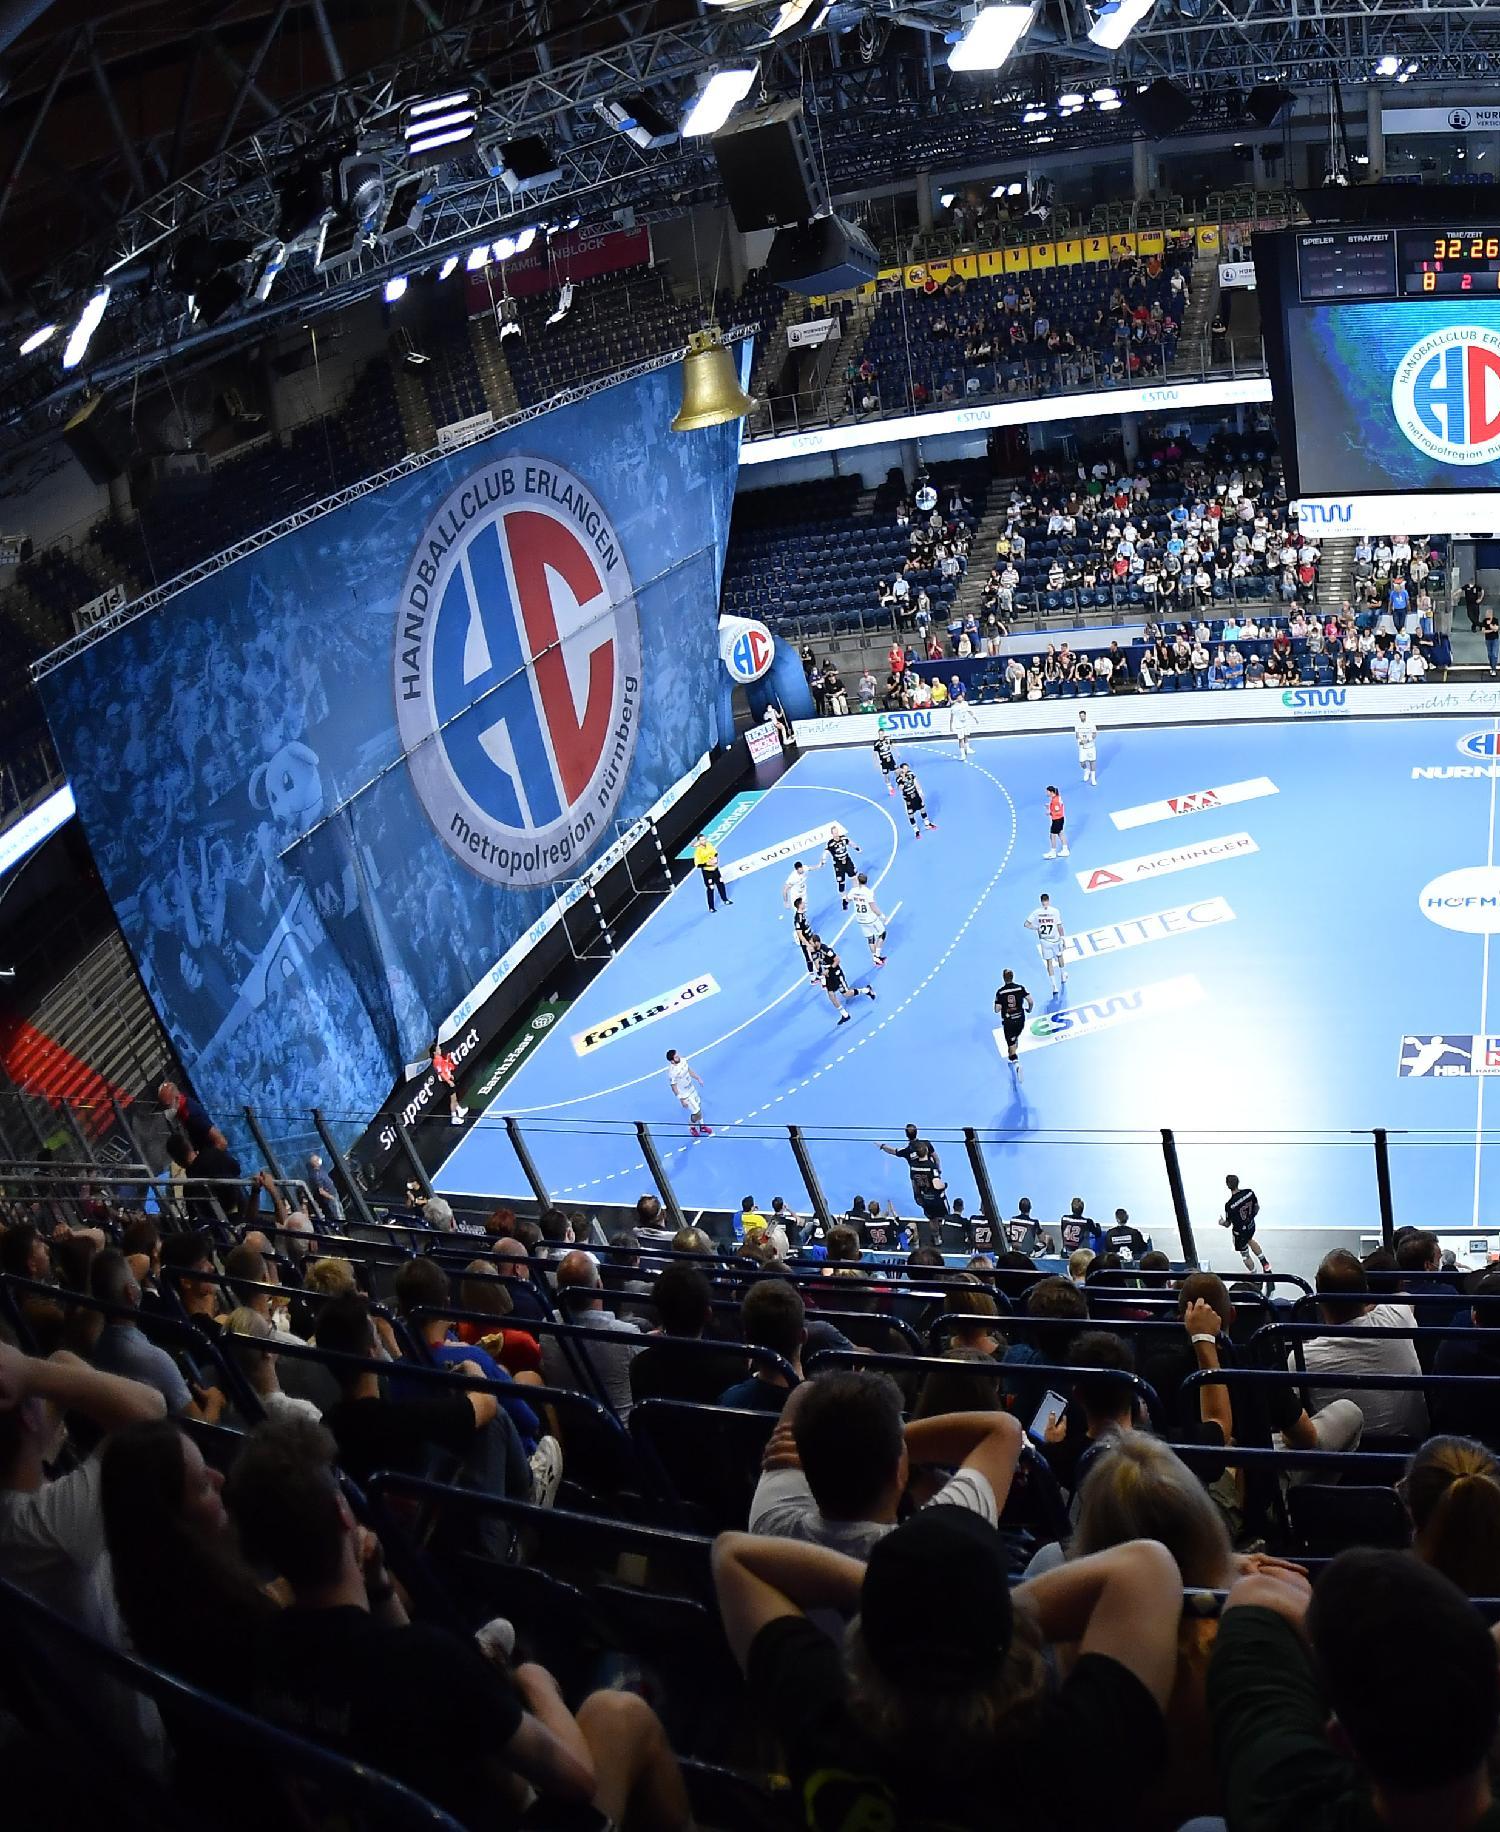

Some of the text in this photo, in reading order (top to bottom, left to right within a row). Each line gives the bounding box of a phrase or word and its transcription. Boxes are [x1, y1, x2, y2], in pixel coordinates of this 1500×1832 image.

[1302, 234, 1389, 246] SPIELER STRAFZEIT
[1423, 272, 1436, 291] 8
[1461, 274, 1472, 289] 2
[1400, 331, 1477, 384] HANDBALLCLUB
[1407, 420, 1483, 461] metropolregion
[403, 467, 619, 700] HANDBALLCLUB ERLANGEN
[451, 811, 596, 875] metropolregion
[597, 675, 638, 809] nürnberg
[1136, 838, 1251, 873] AICHINGER
[856, 904, 868, 914] 28
[1040, 924, 1053, 935] 27
[491, 960, 510, 985] DKB
[1007, 994, 1017, 1008] 9
[582, 981, 709, 1048] folia.de
[450, 1028, 480, 1066] tract
[478, 1032, 534, 1096] BarthHaas
[1434, 1064, 1471, 1077] HBL
[975, 1227, 992, 1243] 27
[1011, 1226, 1028, 1242] 57
[1064, 1225, 1081, 1242] 42
